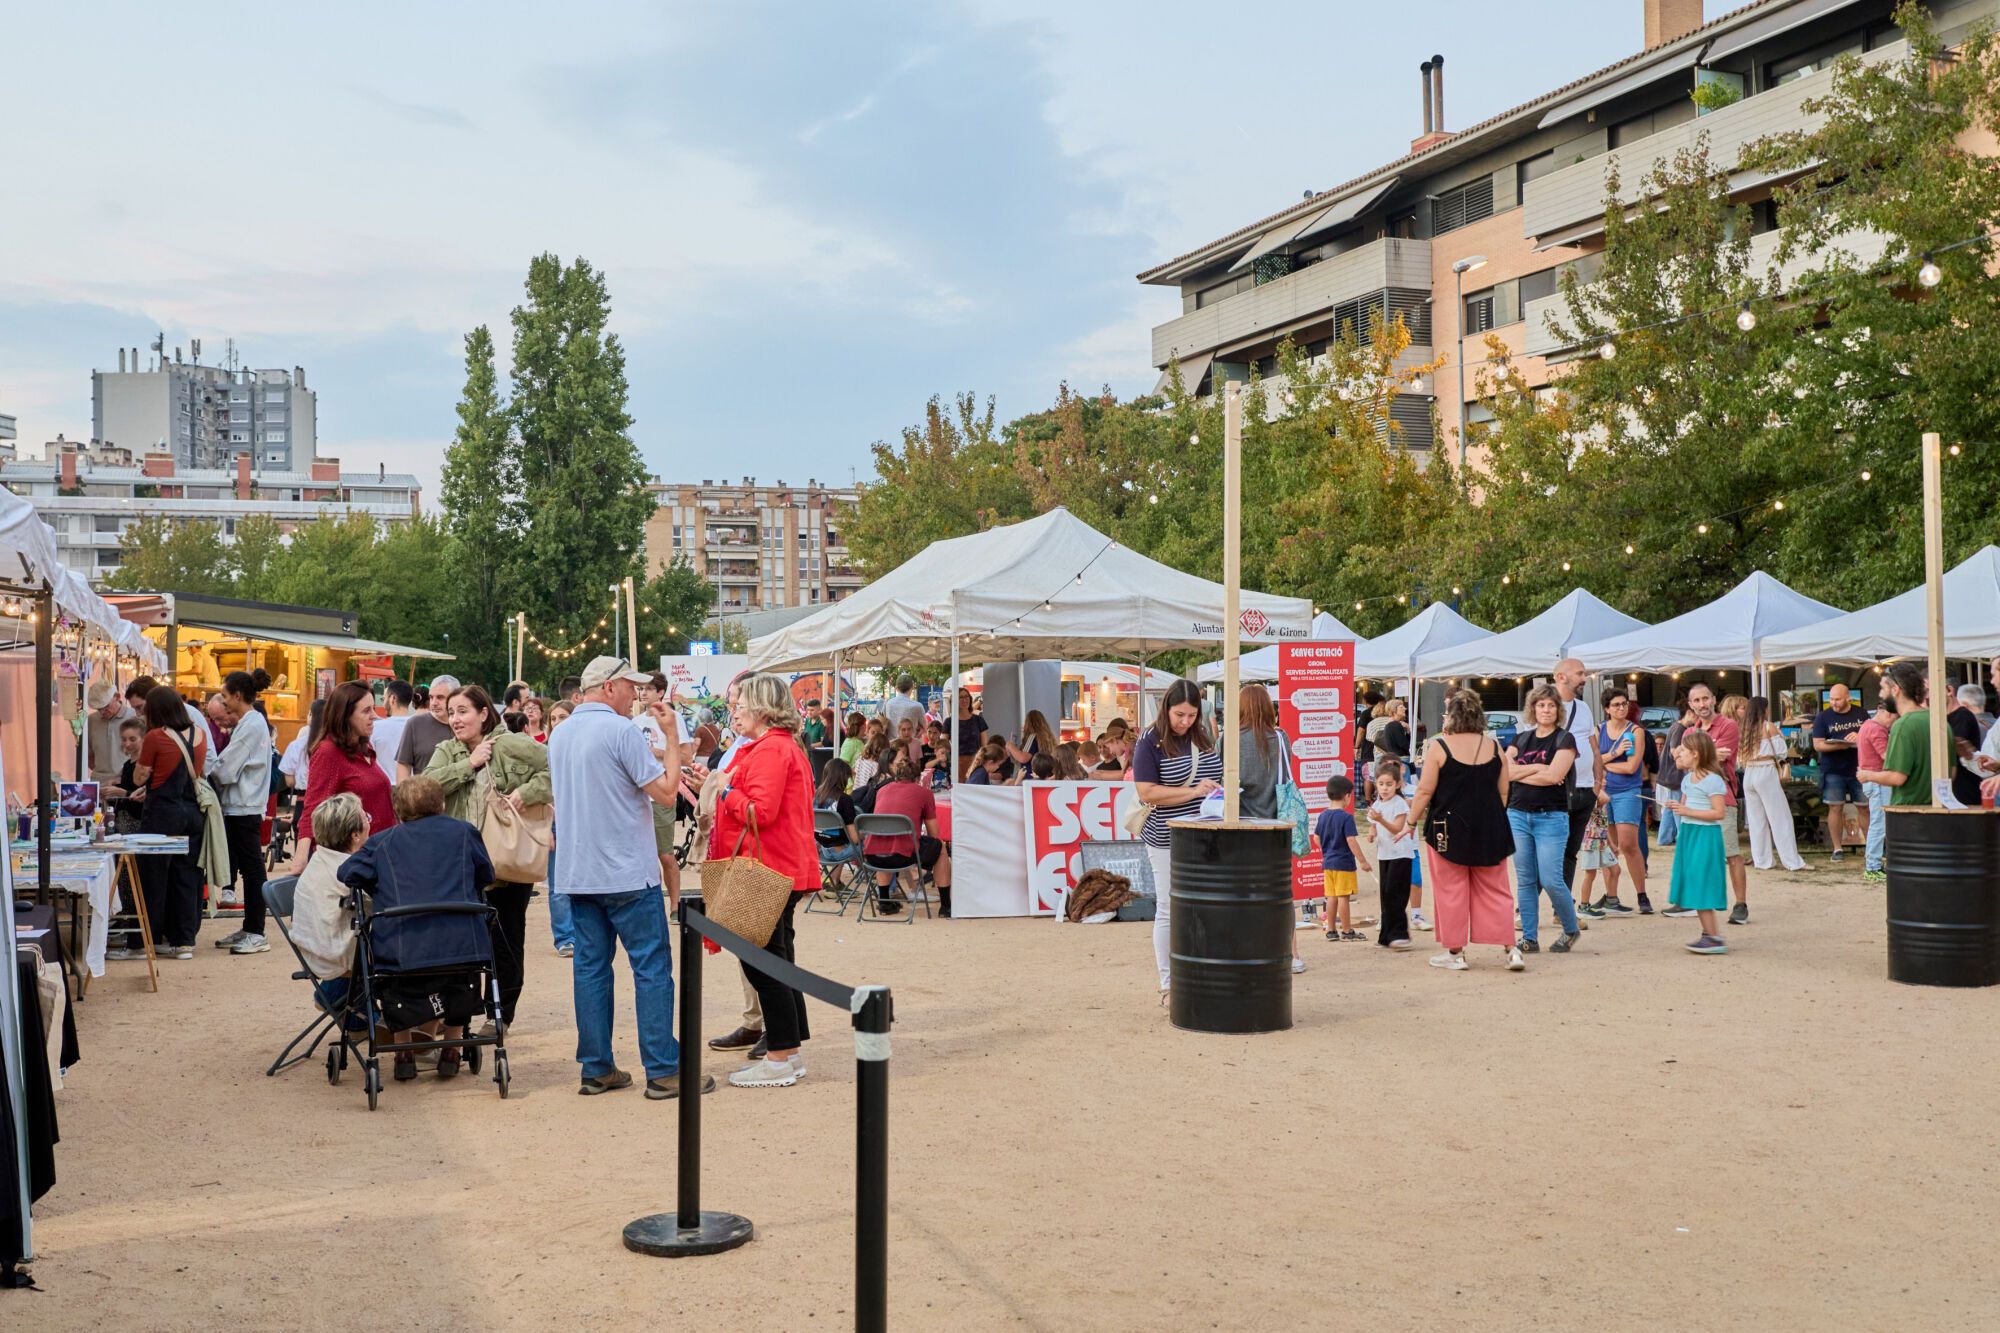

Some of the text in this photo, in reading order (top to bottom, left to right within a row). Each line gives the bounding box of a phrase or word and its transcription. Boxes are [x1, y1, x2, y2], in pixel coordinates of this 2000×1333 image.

[1265, 626, 1275, 636] de
[1279, 627, 1308, 637] Girona
[1291, 646, 1343, 657] SERVEI ESTACIÓ
